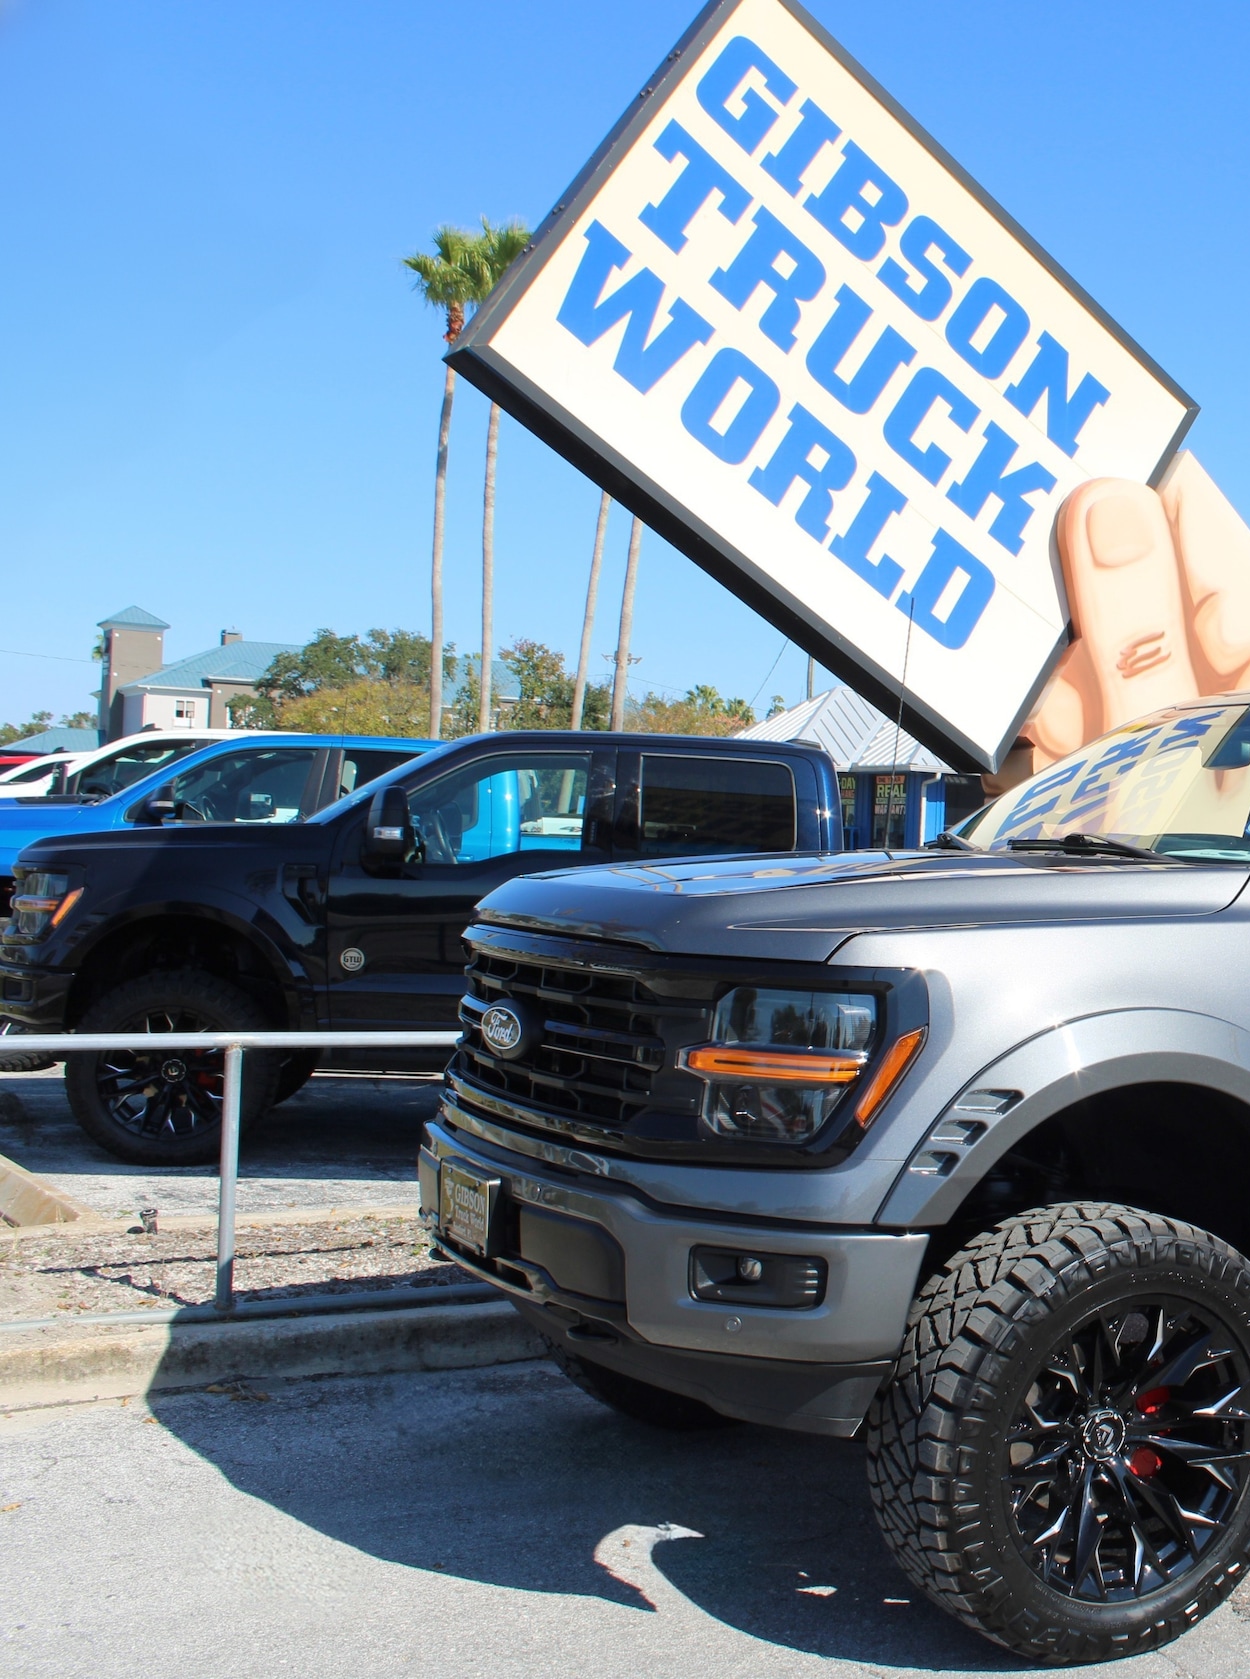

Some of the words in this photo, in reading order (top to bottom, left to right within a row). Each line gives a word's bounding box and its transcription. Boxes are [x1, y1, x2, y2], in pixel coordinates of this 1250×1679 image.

[695, 35, 1111, 459] GIBSON
[639, 119, 1057, 557] TRUCK
[556, 219, 996, 651] WORLD
[876, 784, 907, 798] REAL
[874, 804, 907, 815] WARANTY
[487, 1010, 514, 1043] Ford
[455, 1184, 485, 1215] GIBSON
